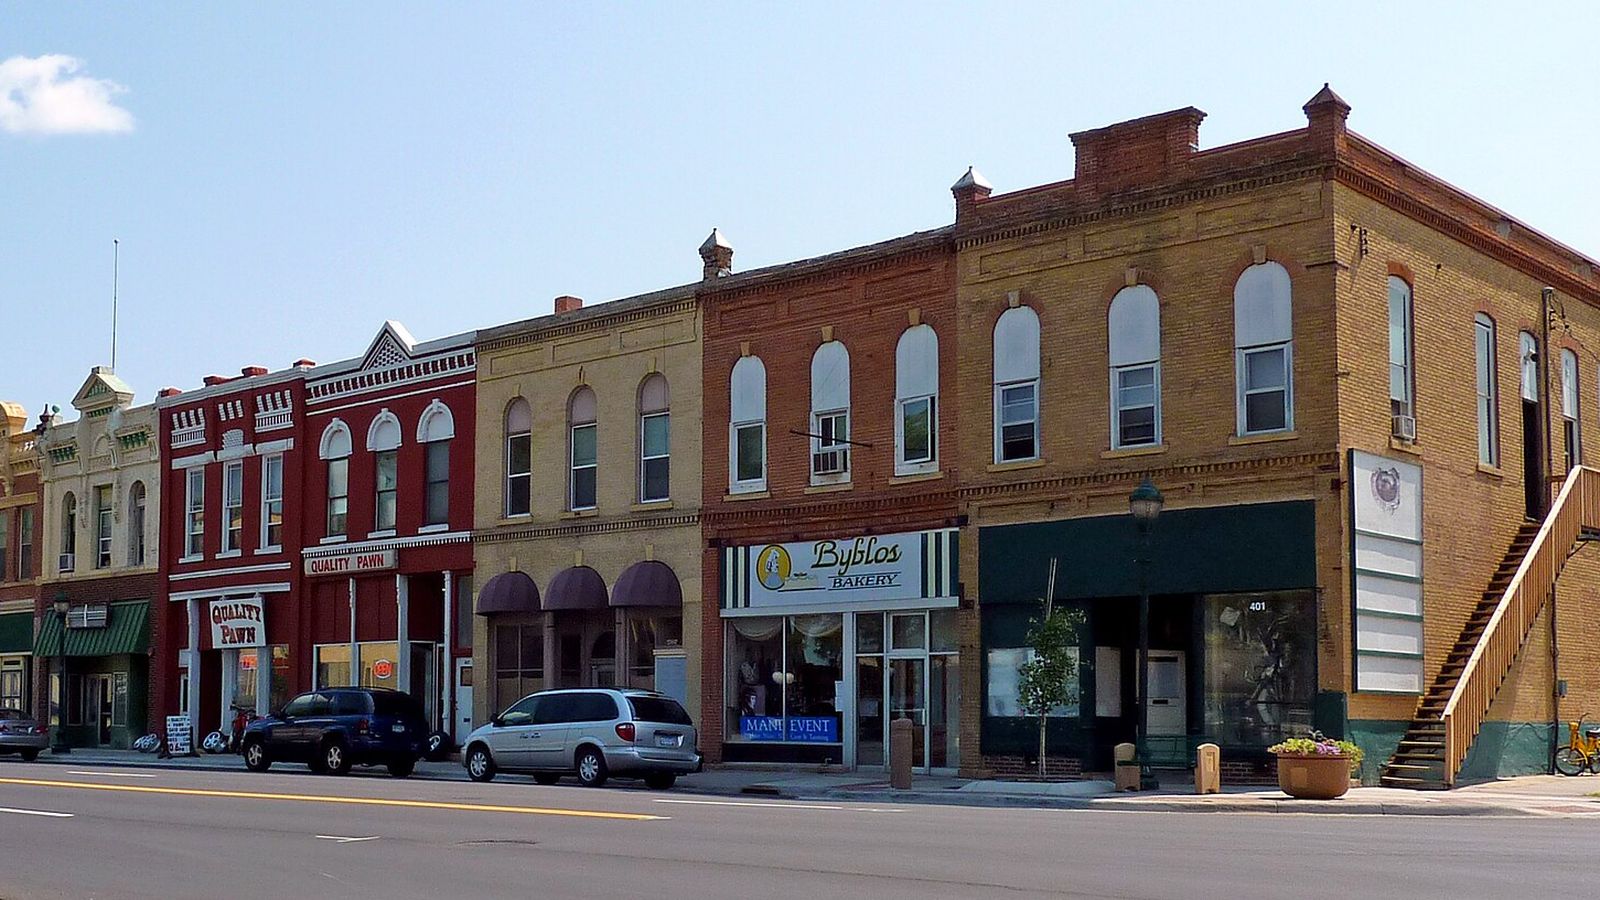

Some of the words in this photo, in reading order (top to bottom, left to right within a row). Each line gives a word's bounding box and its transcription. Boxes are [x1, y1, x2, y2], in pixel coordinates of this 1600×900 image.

[311, 557, 350, 573] QUALITY
[357, 554, 384, 569] PAWN
[811, 536, 903, 576] Byblos
[832, 574, 898, 589] BAKERY
[212, 604, 261, 625] QUALITY
[1249, 601, 1266, 611] 401
[220, 625, 256, 644] PAWN
[790, 719, 830, 732] EVENT
